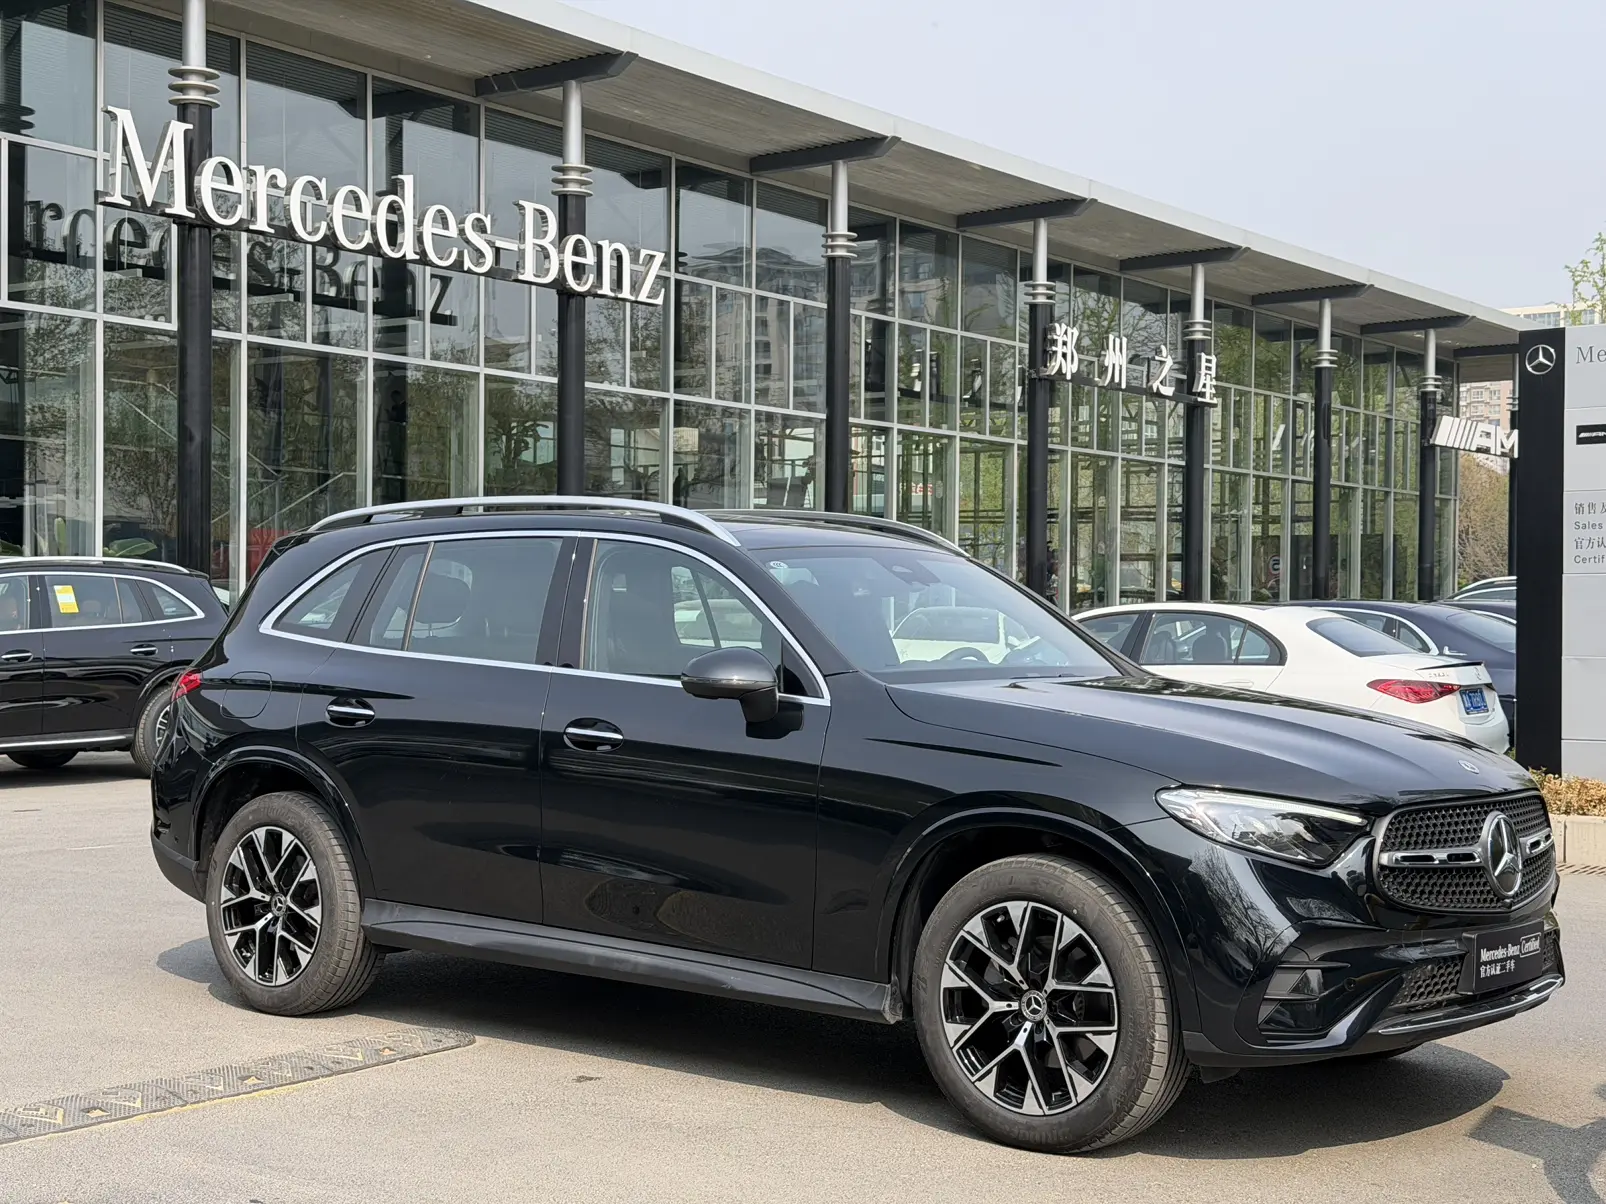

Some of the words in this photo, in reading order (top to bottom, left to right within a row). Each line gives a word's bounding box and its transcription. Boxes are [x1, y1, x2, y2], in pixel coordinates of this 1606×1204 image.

[101, 106, 667, 306] Mercedes-Benz
[1046, 322, 1218, 405] 郑州之星
[1576, 345, 1606, 364] Me
[1574, 520, 1603, 530] Sales
[1574, 554, 1605, 564] Certif
[1480, 943, 1520, 962] Mercedes-Benz
[1521, 936, 1540, 954] Certified
[1480, 959, 1516, 978] 官方认证二手车
